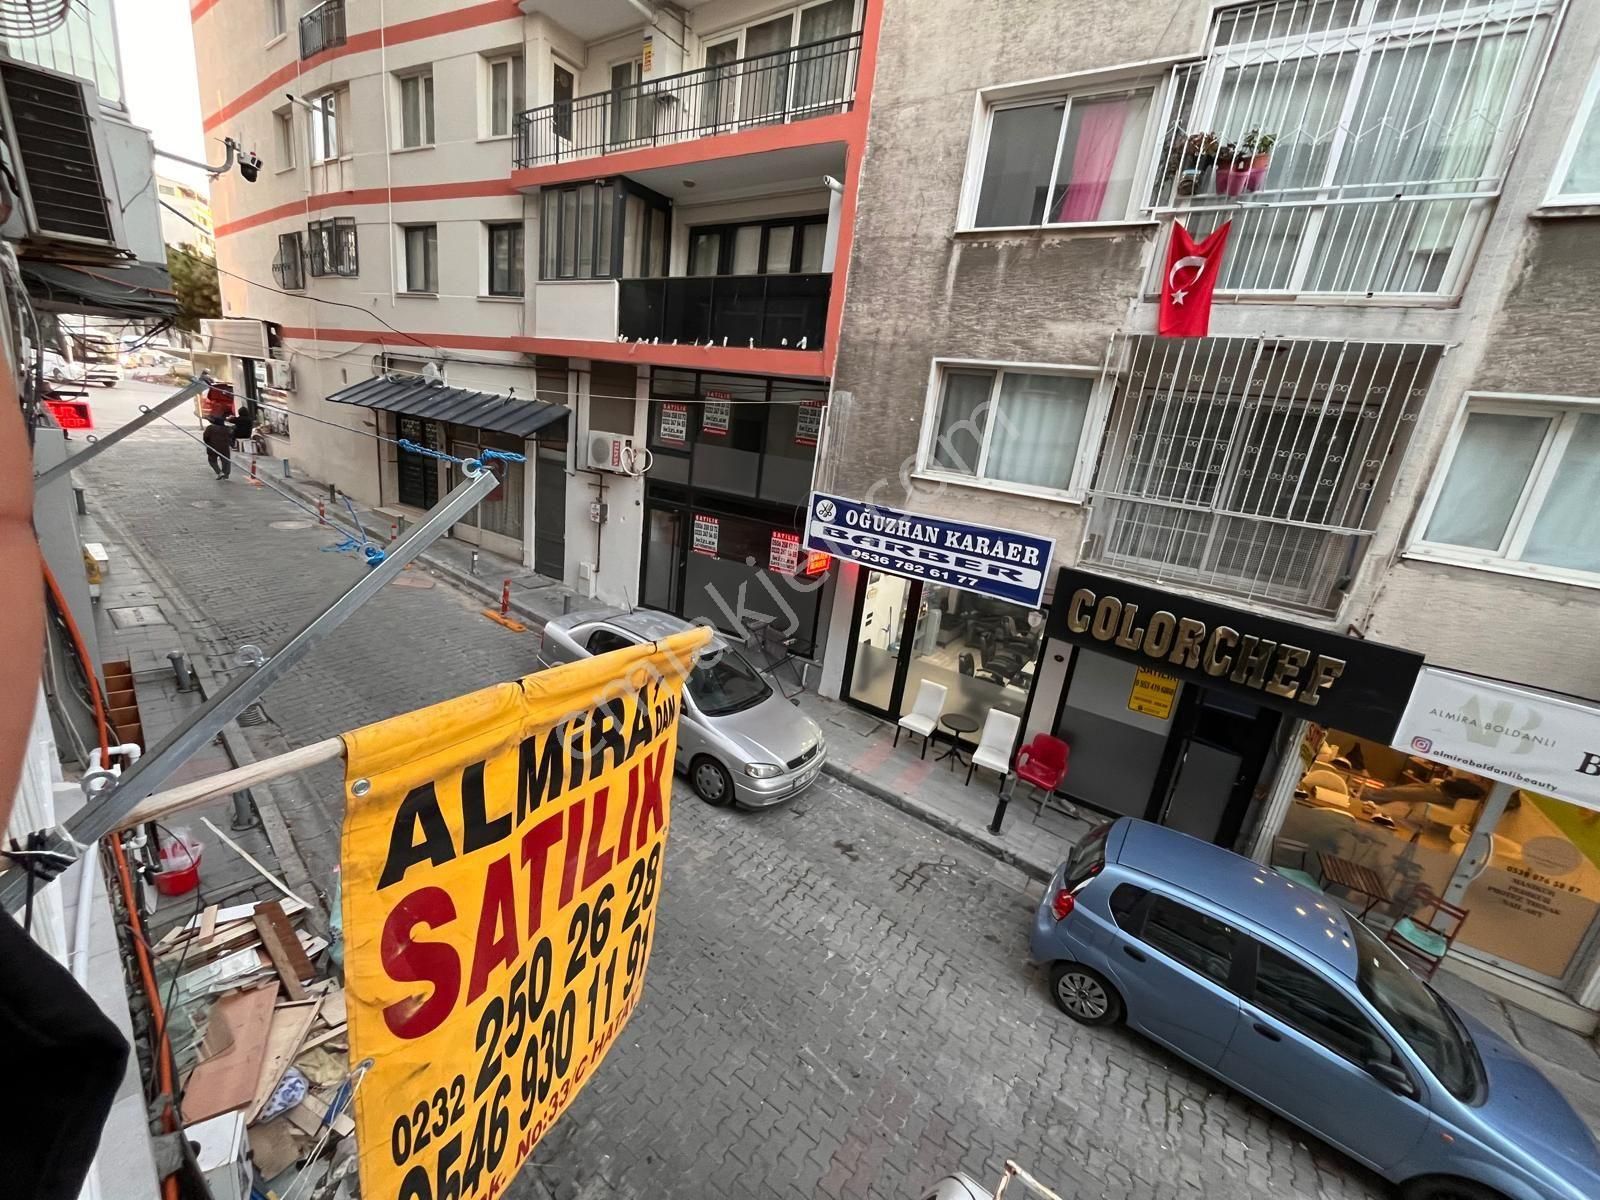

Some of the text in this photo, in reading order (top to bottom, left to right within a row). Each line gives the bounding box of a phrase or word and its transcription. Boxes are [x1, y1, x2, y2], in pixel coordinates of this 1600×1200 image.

[695, 514, 718, 524] SATILIK
[772, 531, 800, 542] SATILIK
[845, 508, 1040, 566] OĞUZHAN KARAER
[823, 525, 1024, 583] BARBER
[851, 549, 979, 587] 0536 782 61 77
[1067, 588, 1347, 706] COLORCHEF
[1429, 708, 1557, 748] ALMİRA BOLDANLI
[1433, 750, 1558, 792] almiraboldanlibeauty
[381, 738, 669, 1040] SATILIK
[391, 842, 661, 1166] 0232 250 26 28
[519, 990, 576, 1131] 930
[587, 946, 618, 1045] 11
[623, 908, 653, 1000] 91
